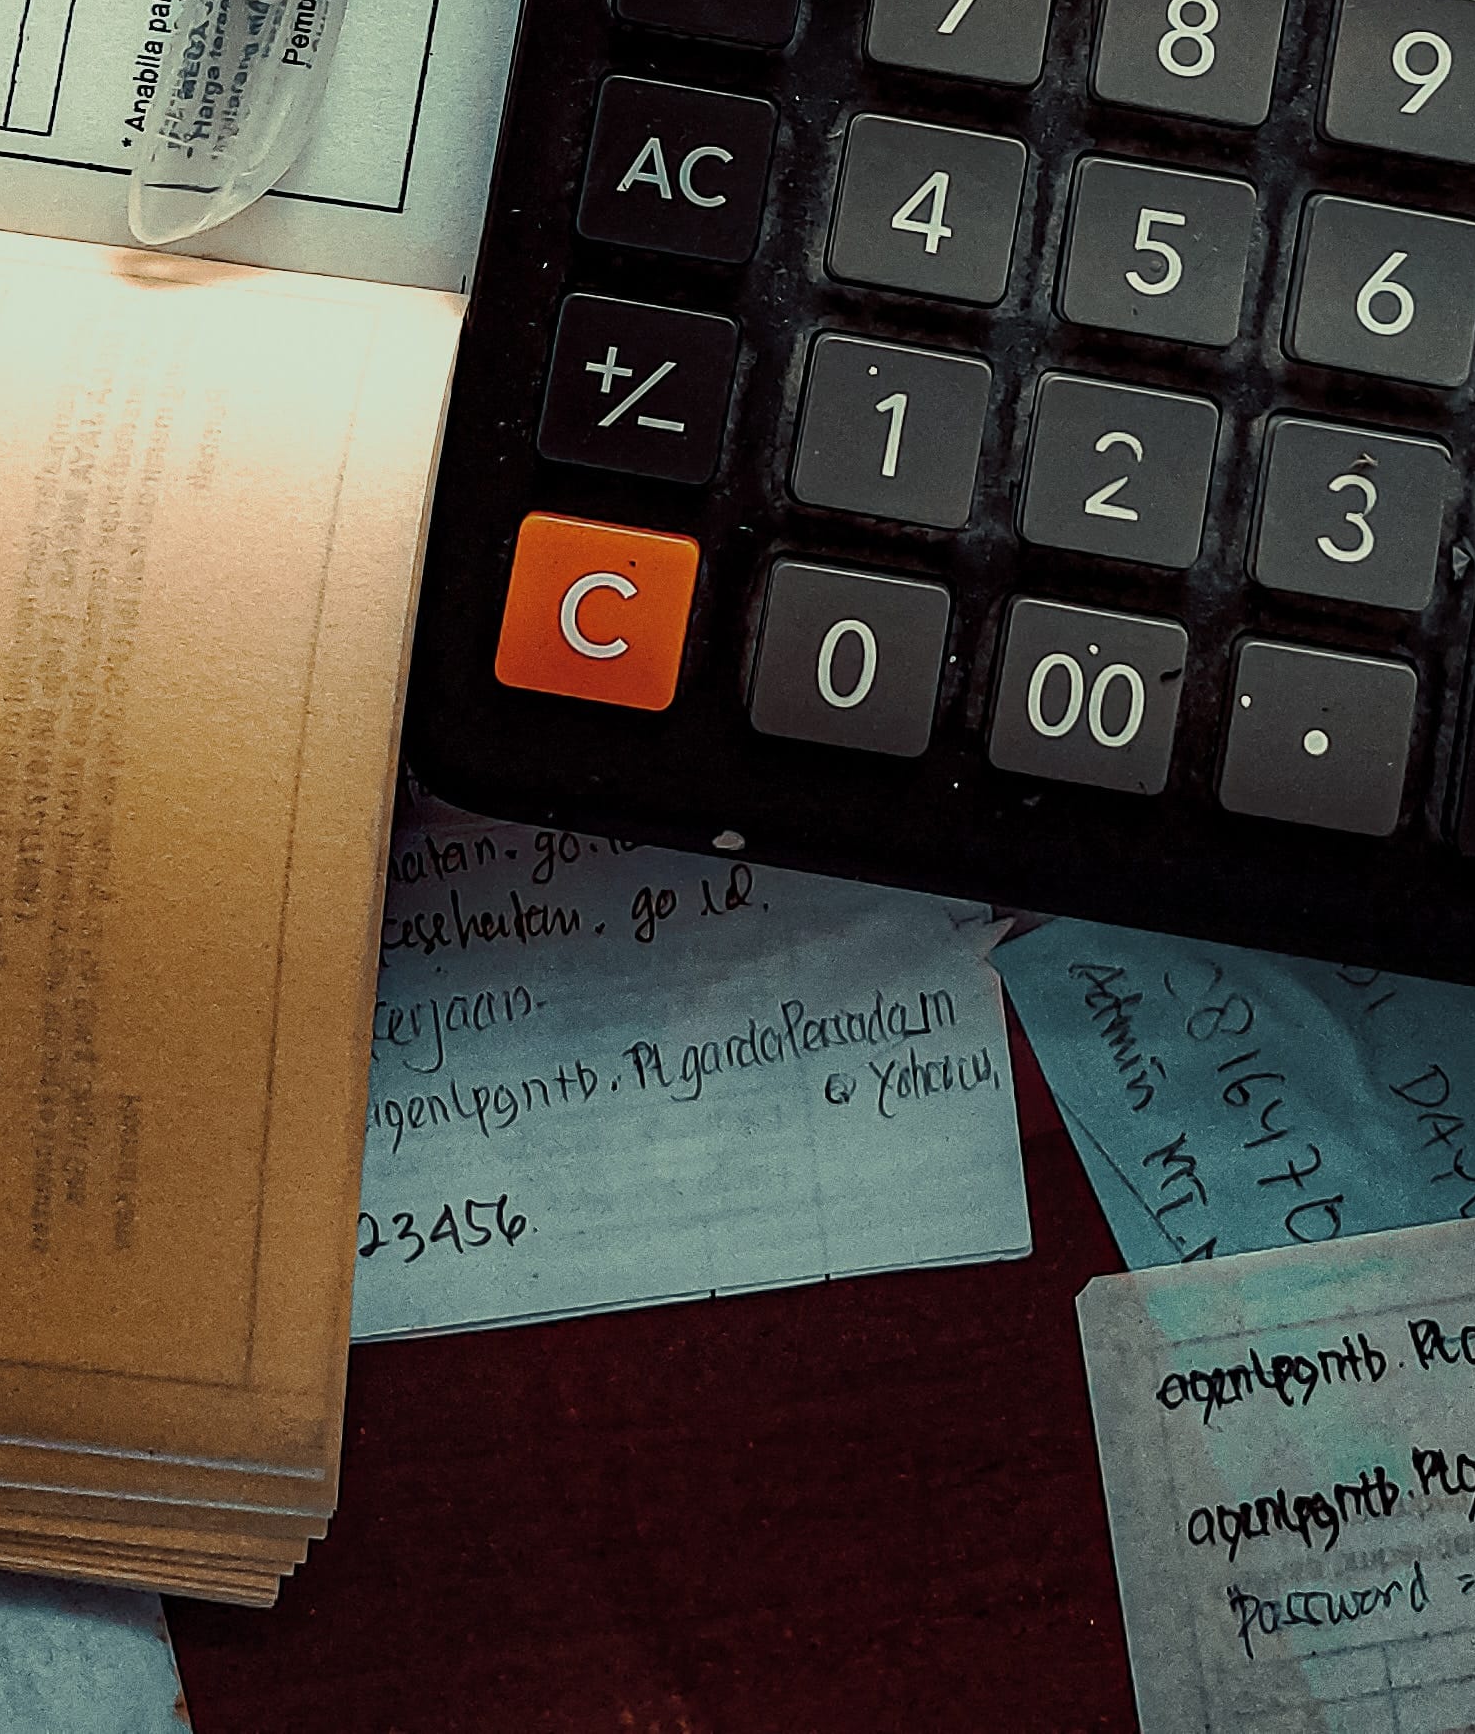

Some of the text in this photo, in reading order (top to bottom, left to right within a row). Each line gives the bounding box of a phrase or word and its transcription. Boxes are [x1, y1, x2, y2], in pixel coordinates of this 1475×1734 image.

[1391, 30, 1453, 115] 9
[615, 136, 734, 208] AC
[891, 171, 953, 255] 4
[1124, 207, 1187, 296] 5
[1356, 251, 1415, 336] 6
[874, 392, 909, 478] 1
[1084, 430, 1144, 522] 2
[1317, 473, 1378, 563] 3
[559, 571, 639, 660] C
[817, 618, 878, 709] 0
[1027, 652, 1146, 748] 00
